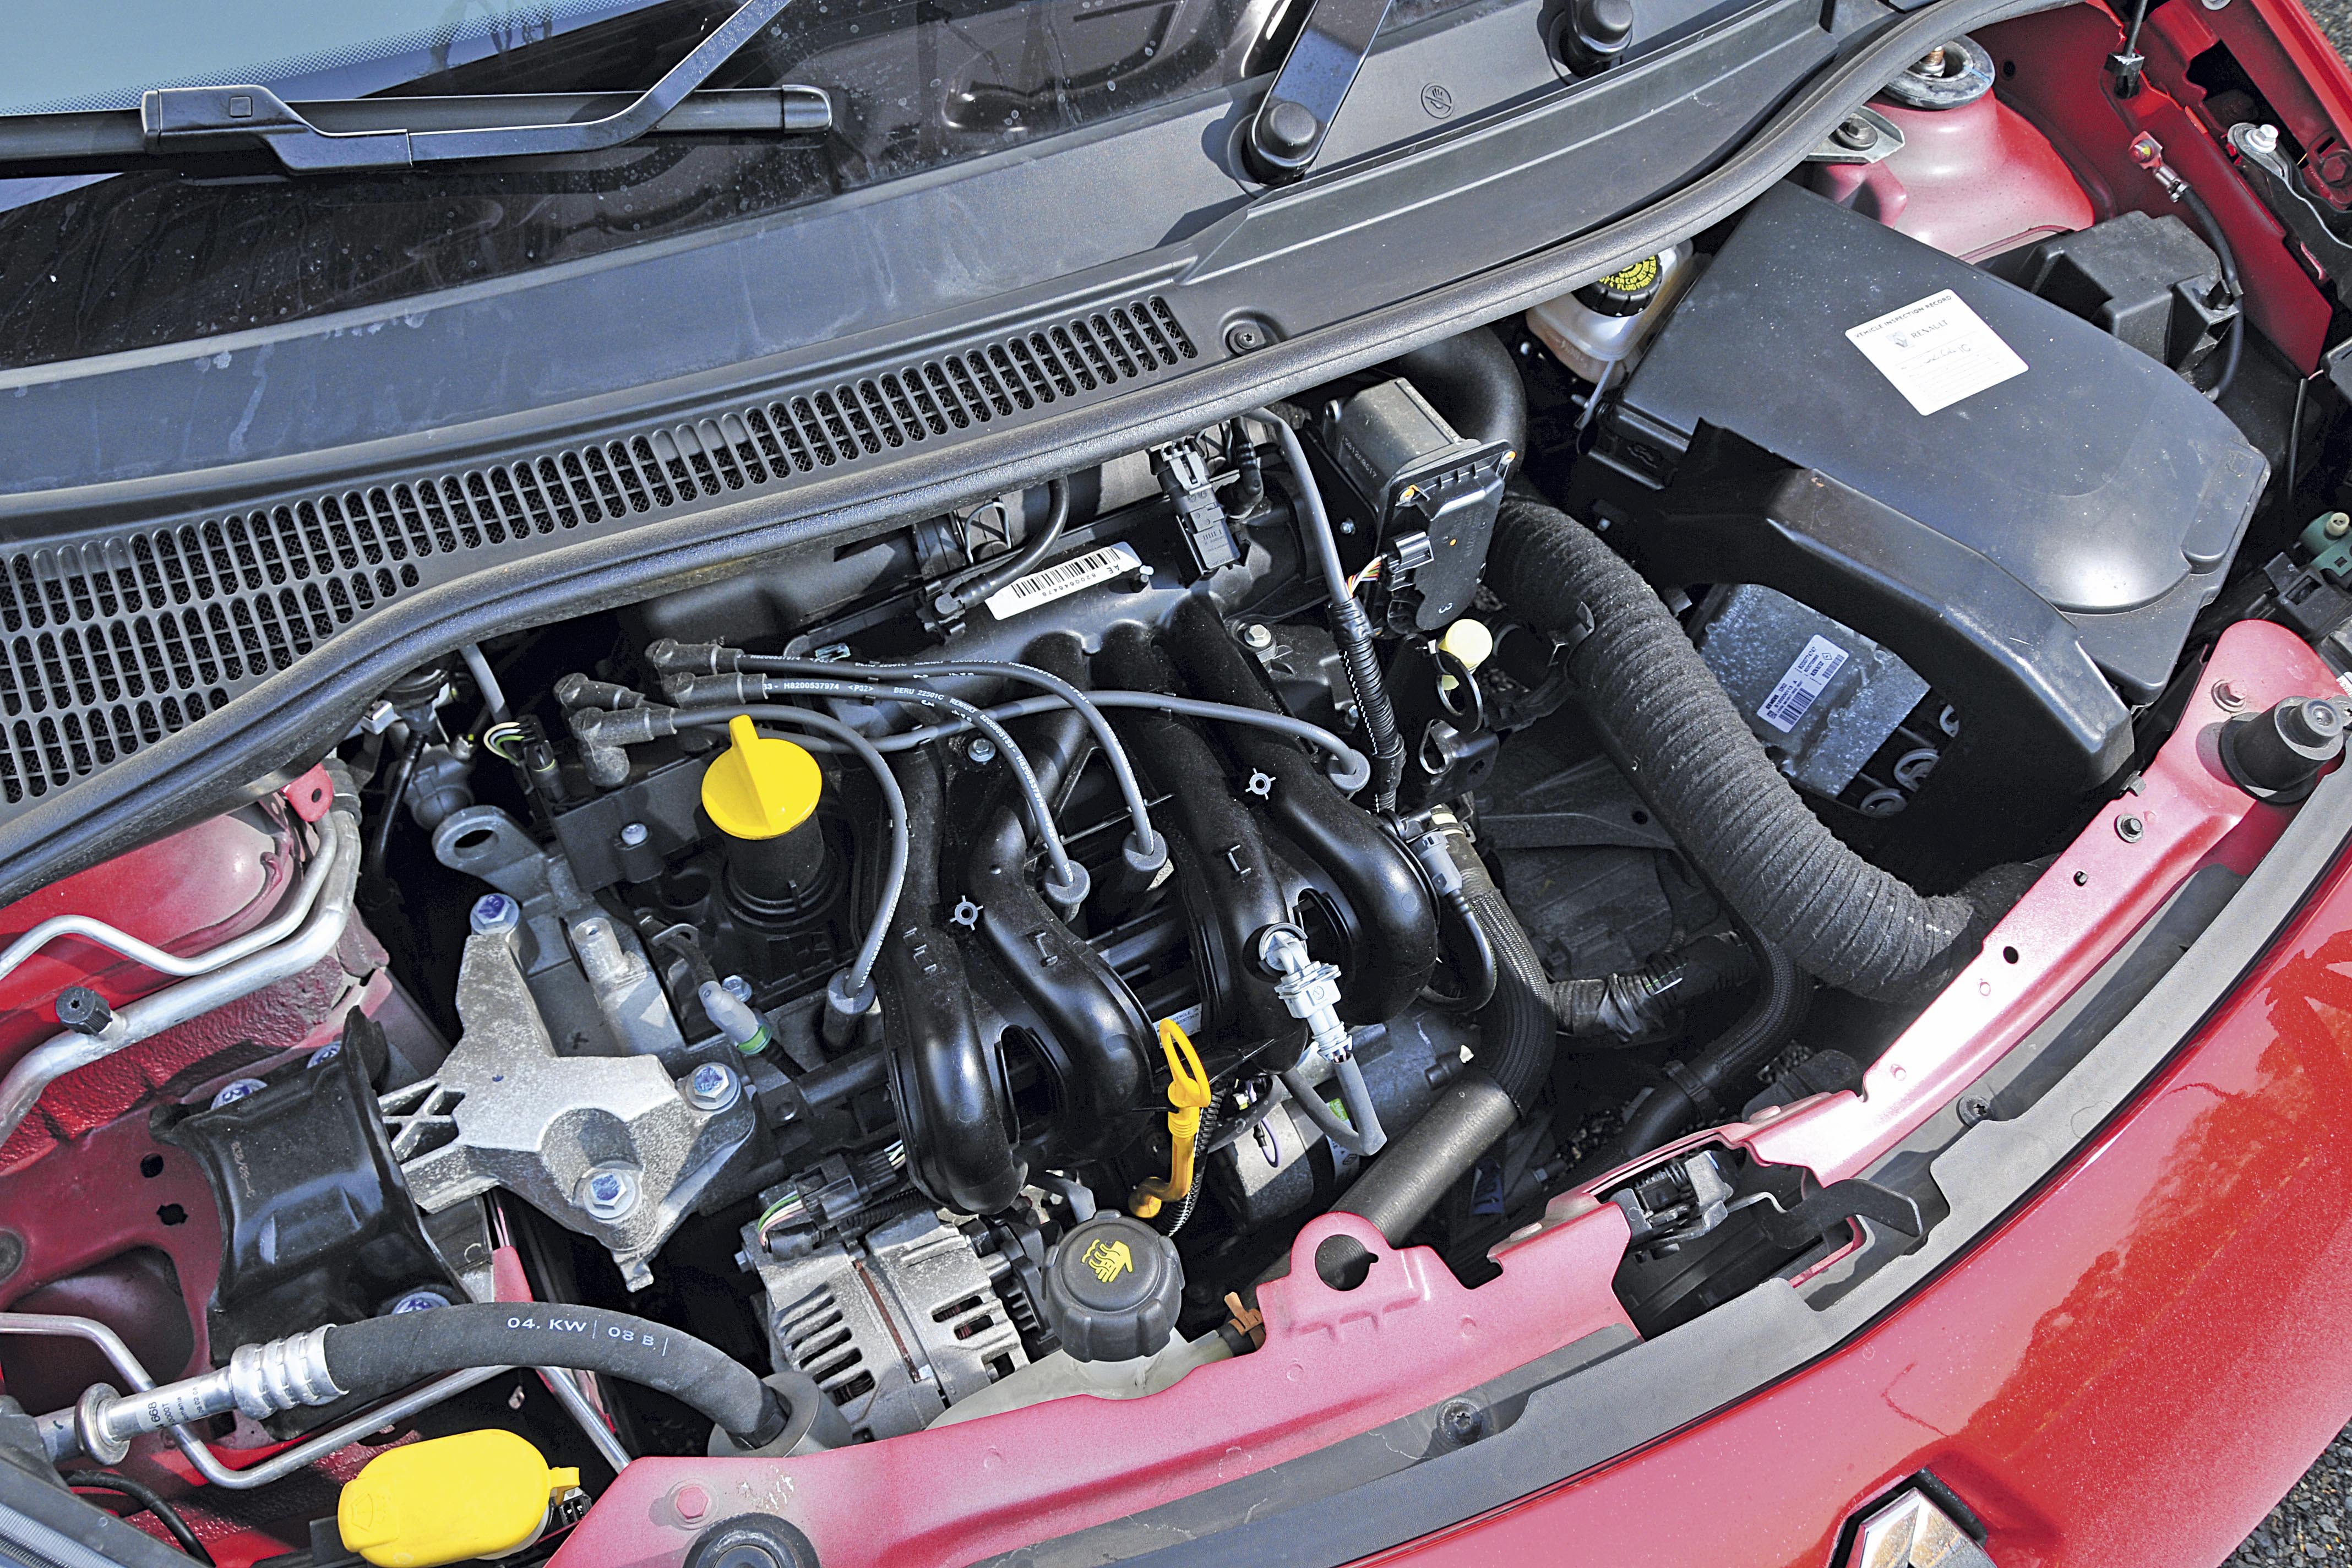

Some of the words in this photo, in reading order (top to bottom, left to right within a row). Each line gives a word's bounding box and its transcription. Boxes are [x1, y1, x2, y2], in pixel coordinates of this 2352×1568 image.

[1854, 324, 1883, 339] VEHICLE
[1883, 307, 1925, 327] INSPECTION
[1925, 295, 1952, 310] RECORD
[1910, 319, 1949, 339] RENAULT
[1107, 564, 1120, 574] AE
[894, 686, 915, 695] BERU
[917, 689, 945, 701] 22501C
[949, 697, 979, 715] RENAULT
[1015, 754, 1044, 808] H8200537974
[507, 1316, 541, 1331] 04.
[548, 1318, 588, 1332] KW
[608, 1326, 635, 1341] 08
[148, 1402, 161, 1423] 668
